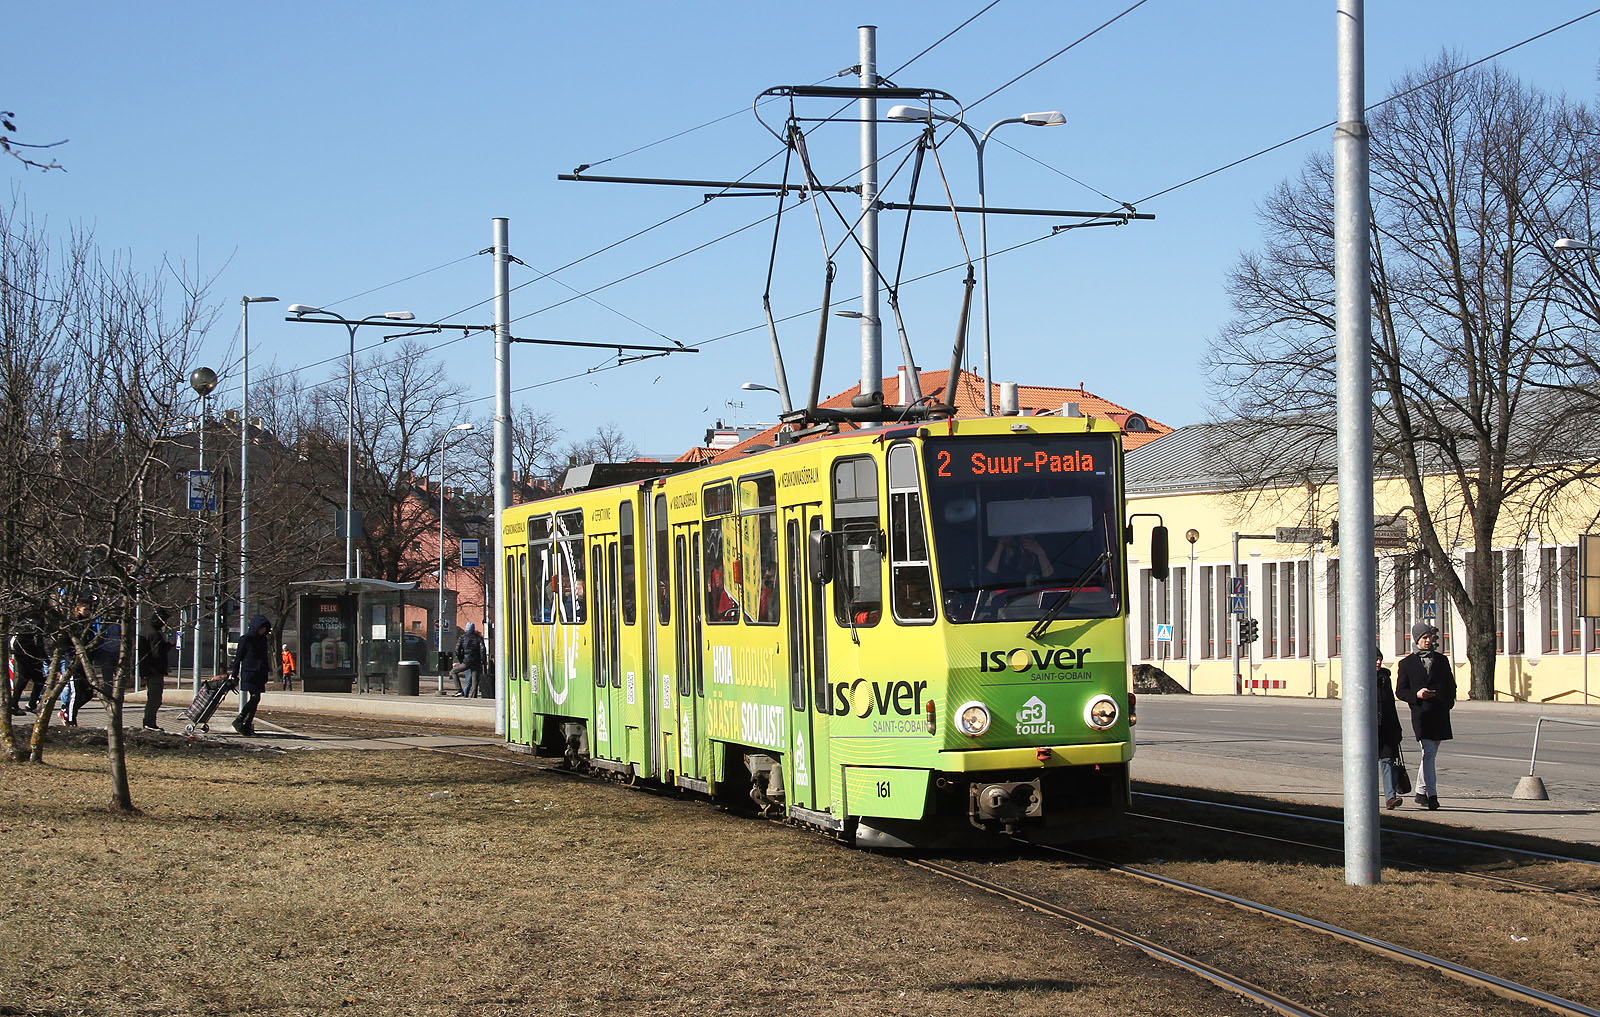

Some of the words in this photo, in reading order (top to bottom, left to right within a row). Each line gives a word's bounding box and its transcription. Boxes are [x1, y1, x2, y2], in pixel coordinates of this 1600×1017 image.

[936, 450, 952, 477] 2
[970, 450, 1094, 475] Suur-Paala
[320, 604, 337, 612] FELIX
[712, 645, 734, 685] HOIA
[734, 646, 777, 696] LOODUST,
[1031, 671, 1092, 682] SAINT-GOBAIN
[707, 690, 740, 740] SÄÄSTA
[740, 701, 786, 749] SOOJUST!
[1016, 703, 1044, 723] G3
[1015, 721, 1055, 735] touch
[876, 781, 891, 799] 161
